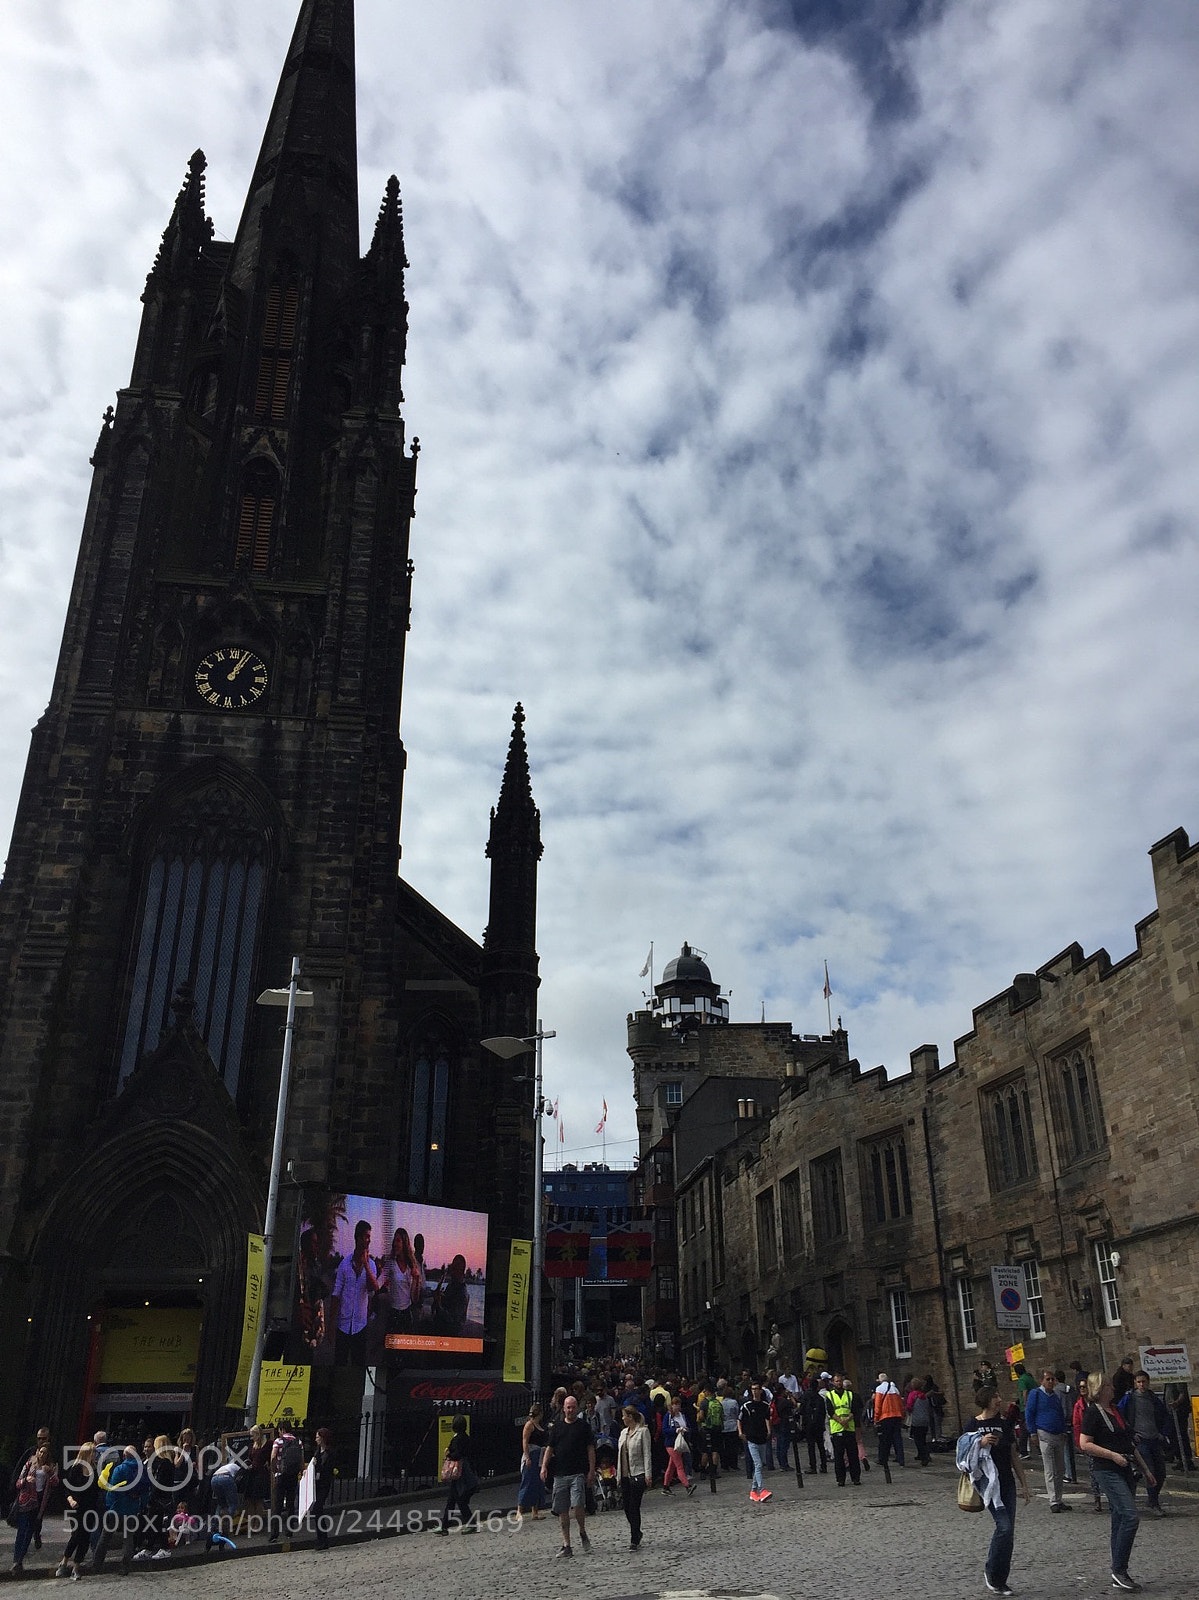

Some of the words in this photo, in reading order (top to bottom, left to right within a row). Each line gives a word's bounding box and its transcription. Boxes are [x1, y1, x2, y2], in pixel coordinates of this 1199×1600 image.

[213, 650, 226, 662] XI
[229, 648, 240, 659] XII
[197, 673, 209, 681] IX
[250, 1273, 260, 1300] HUB
[512, 1272, 523, 1295] HUB
[511, 1300, 520, 1321] THE
[247, 1307, 257, 1331] THE
[133, 1335, 155, 1347] THE
[159, 1335, 183, 1347] HUB
[265, 1368, 283, 1378] THE
[285, 1367, 305, 1378] HUB
